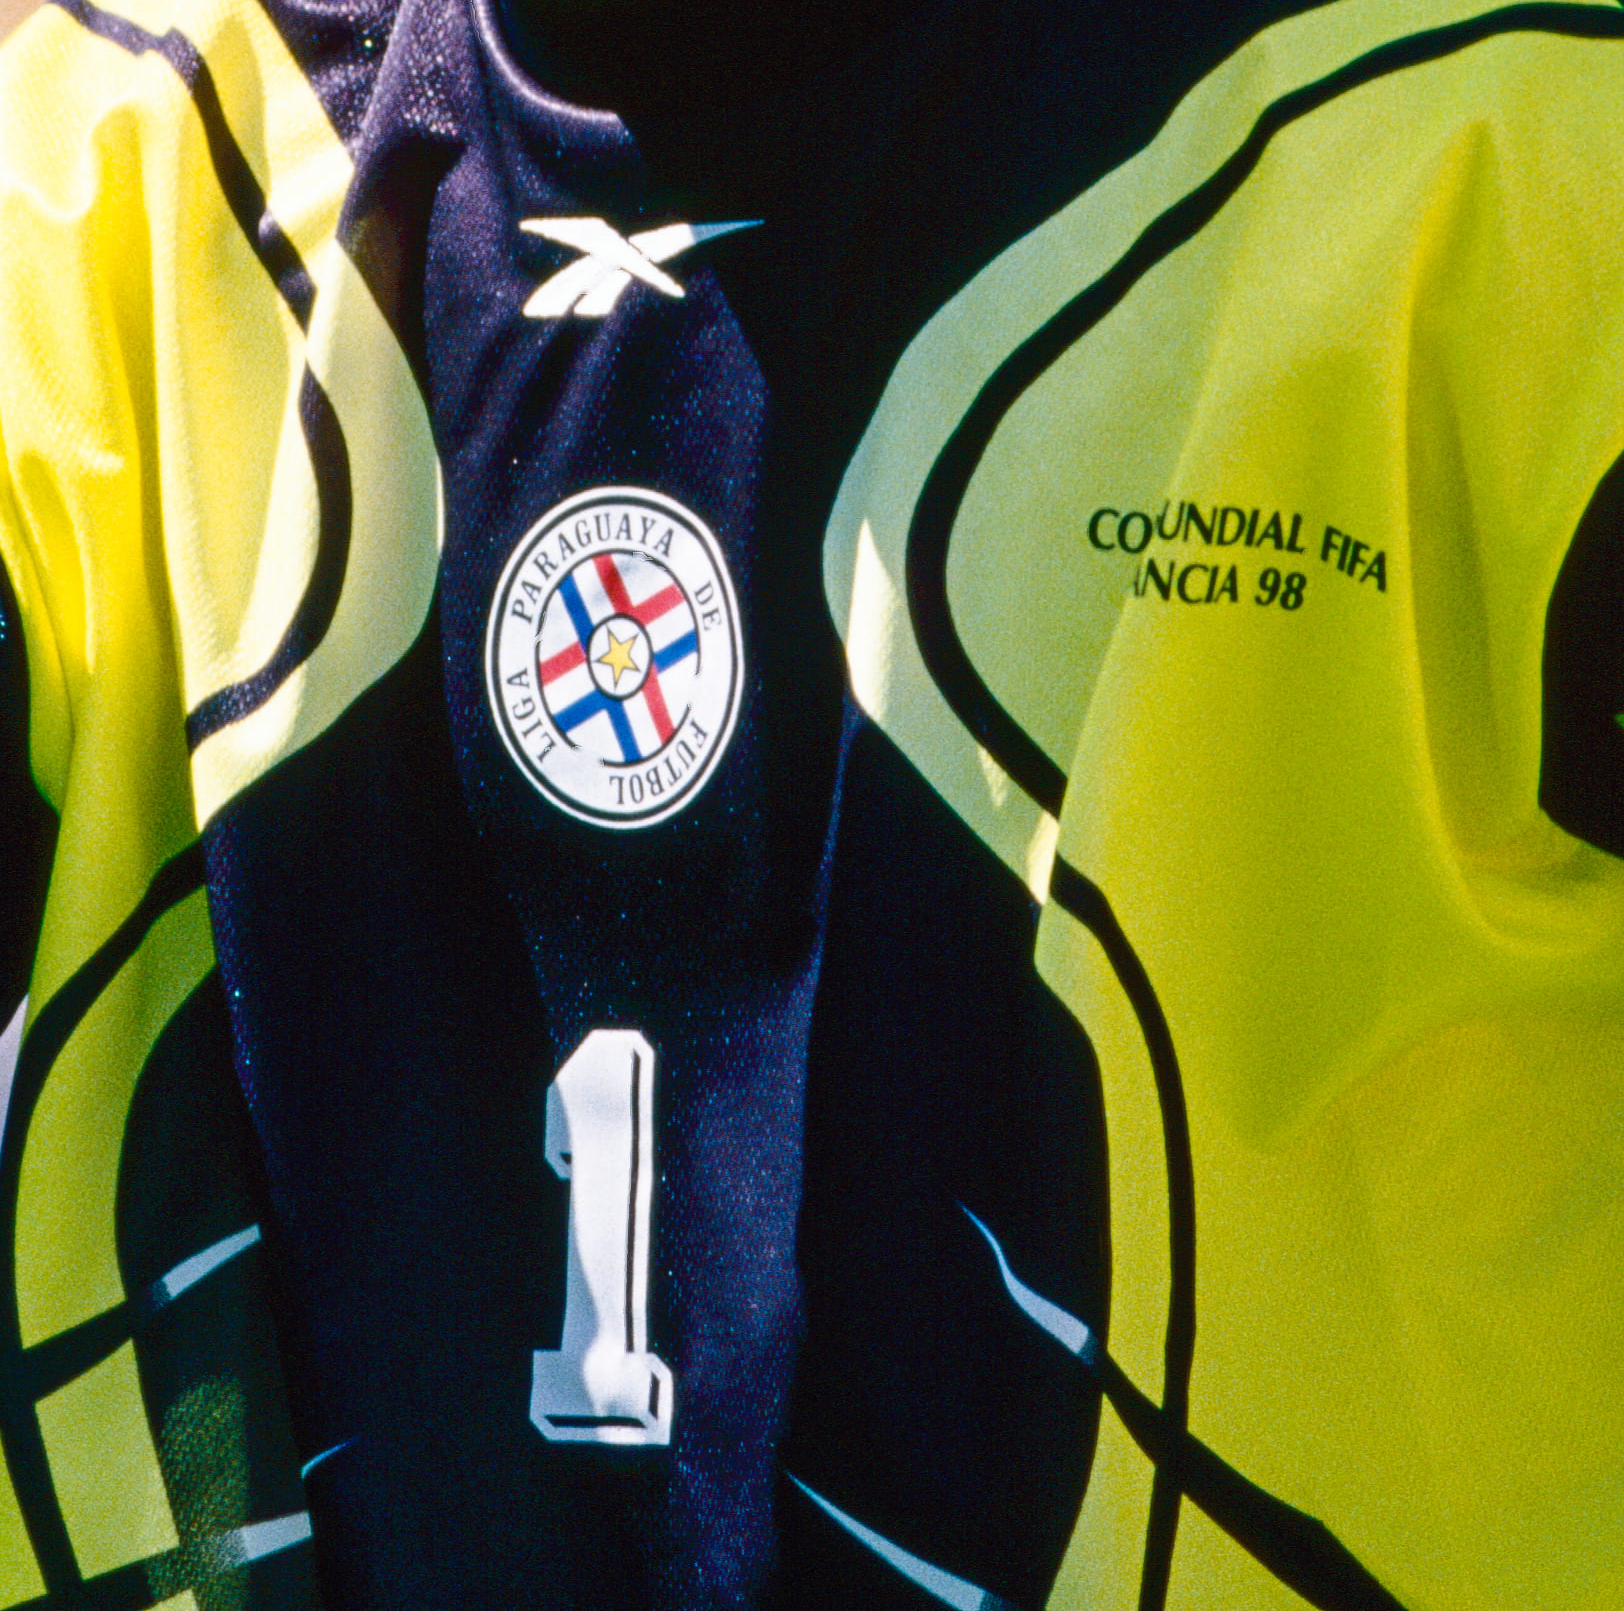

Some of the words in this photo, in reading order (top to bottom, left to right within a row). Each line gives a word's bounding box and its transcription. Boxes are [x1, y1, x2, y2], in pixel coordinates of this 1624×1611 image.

[511, 512, 675, 625] PARAGUAYA
[1133, 557, 1239, 605] NCIA
[1253, 567, 1307, 611] 98
[1320, 524, 1387, 594] FIFA
[694, 581, 722, 631] DE
[507, 668, 557, 763] LIGA
[609, 718, 709, 805] FUTBOL
[529, 1028, 674, 1445] 1
